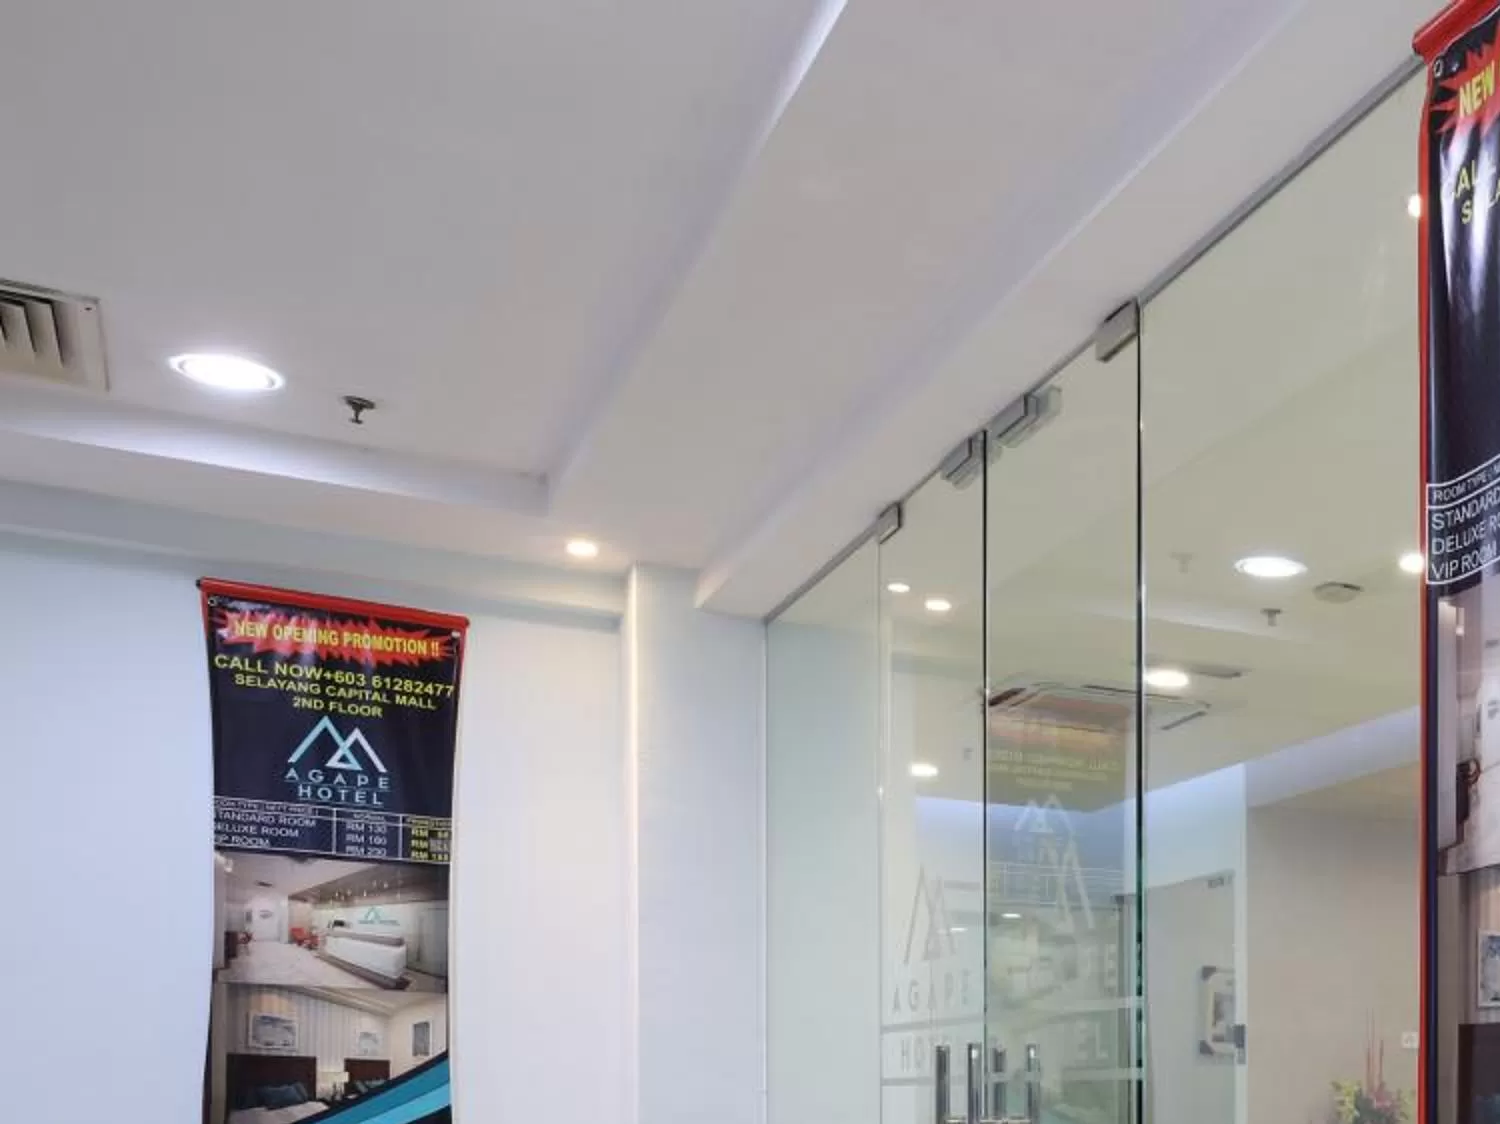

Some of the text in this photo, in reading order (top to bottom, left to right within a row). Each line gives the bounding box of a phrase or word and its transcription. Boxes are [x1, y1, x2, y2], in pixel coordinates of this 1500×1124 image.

[1459, 62, 1495, 118] NEW
[1431, 520, 1486, 555] DELUXE
[1431, 559, 1459, 579] VIP
[234, 620, 268, 638] NEW
[273, 624, 339, 646] OPENING
[343, 630, 427, 655] PROMOTION
[214, 654, 269, 674] CALL
[371, 675, 454, 698] 61282477
[234, 673, 436, 710] SELAYANG CAPITAL MALL
[293, 698, 383, 718] 2ND FLOOR
[285, 768, 390, 789] AGAPE
[298, 783, 382, 805] HOTEL
[213, 808, 276, 824] TANDARD
[261, 825, 299, 838] ROOM
